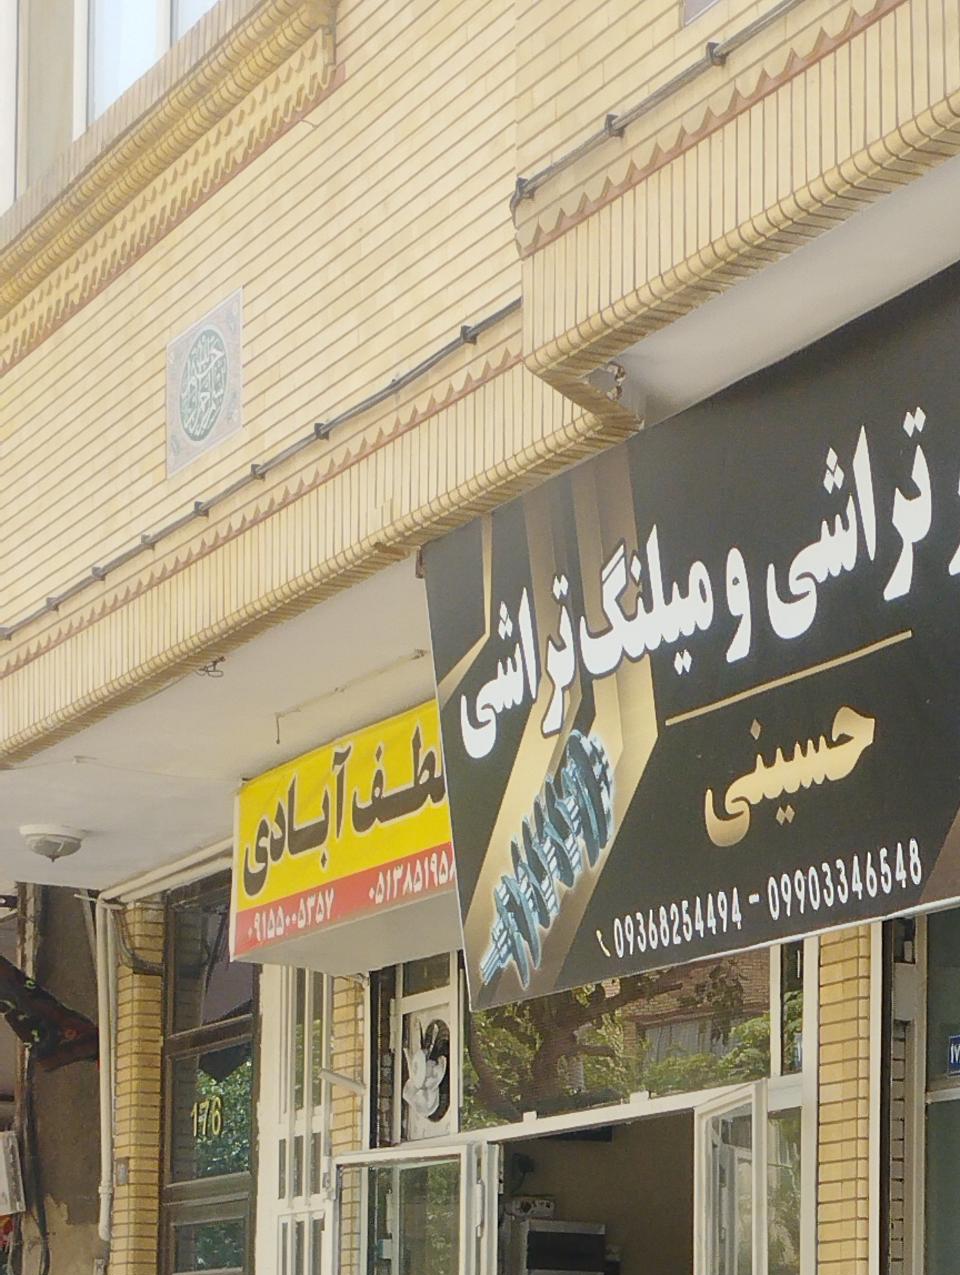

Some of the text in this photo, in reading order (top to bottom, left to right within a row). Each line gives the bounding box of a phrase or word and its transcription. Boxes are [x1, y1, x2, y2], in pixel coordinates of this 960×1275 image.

[766, 406, 932, 640] تراشی
[460, 573, 576, 760] تراشی
[580, 524, 713, 676] میلنگ
[725, 546, 752, 663] و
[243, 723, 449, 897] طف آبادی
[705, 705, 877, 848] حسینی
[612, 886, 742, 959] 09368254494
[767, 837, 923, 921] 09903346548
